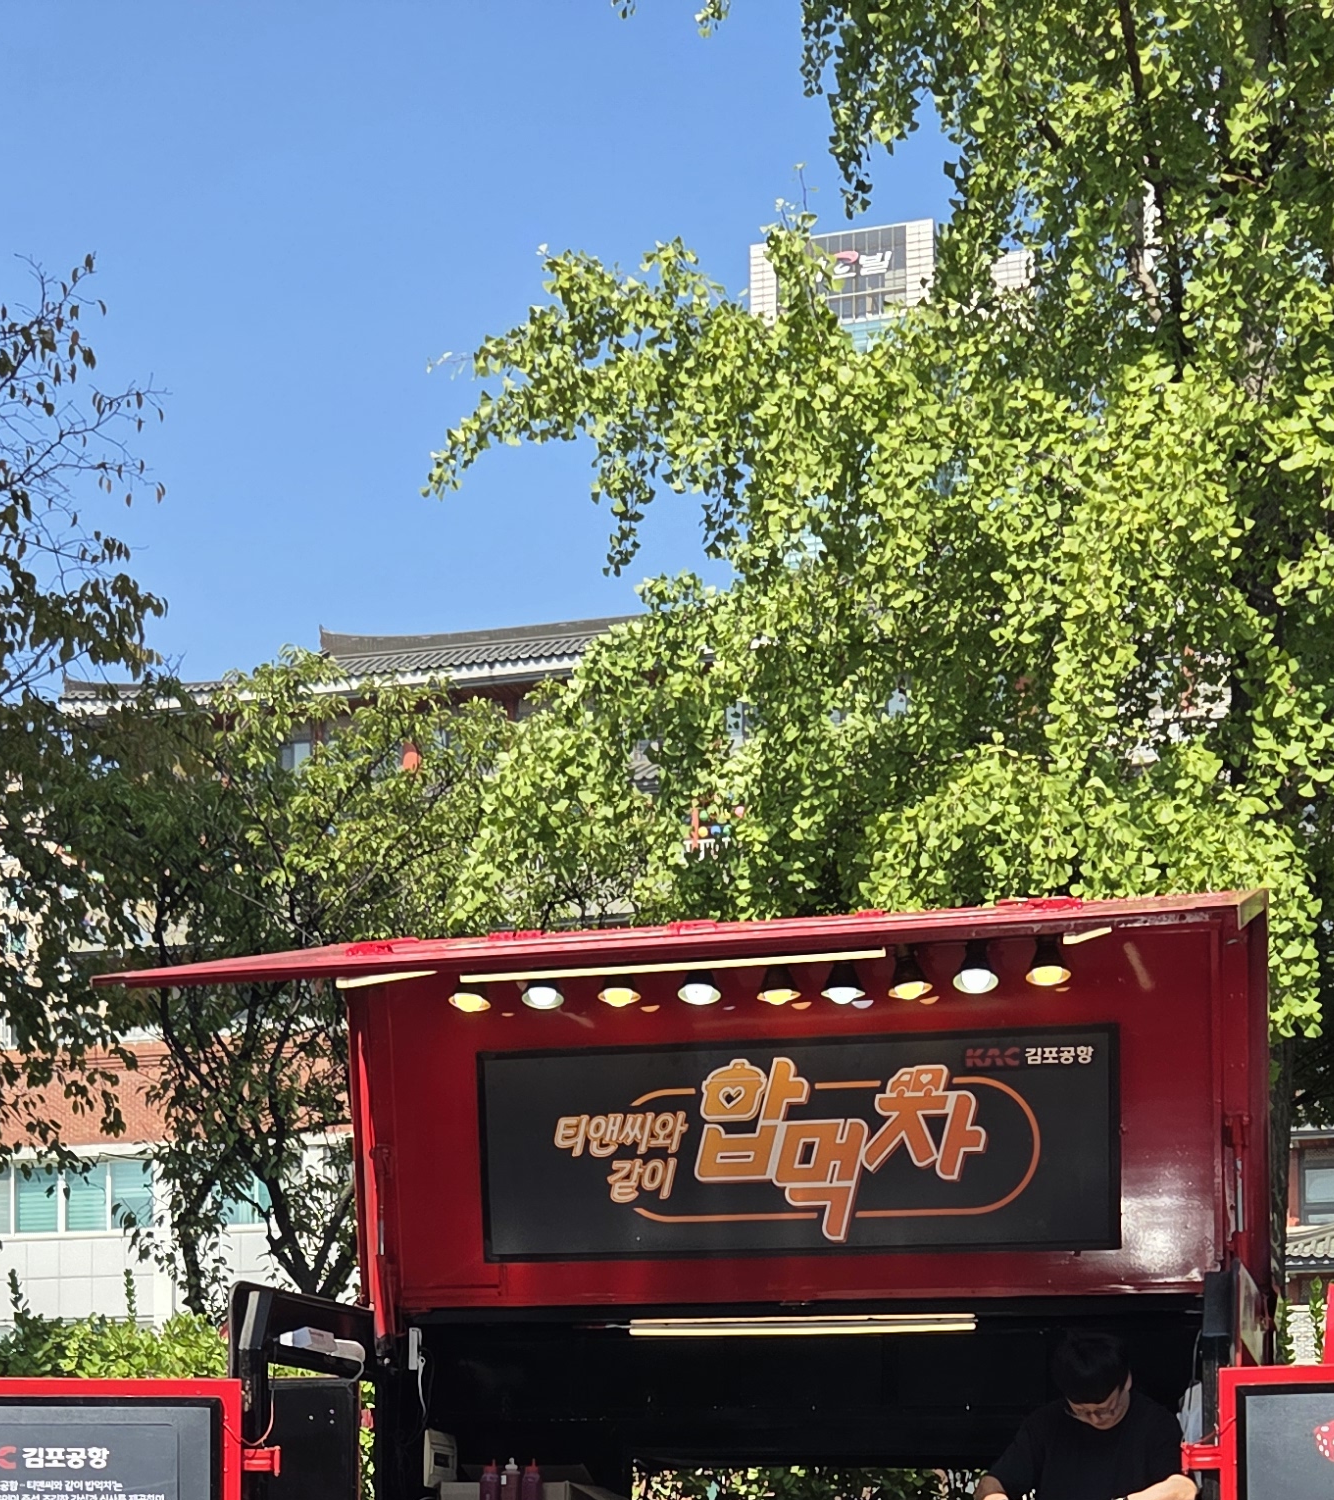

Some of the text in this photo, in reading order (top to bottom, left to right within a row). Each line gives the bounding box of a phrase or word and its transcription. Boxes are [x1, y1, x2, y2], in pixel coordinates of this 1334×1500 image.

[965, 1045, 1095, 1067] KAC 김포공항
[553, 1111, 688, 1158] 티앤씨와
[607, 1158, 677, 1204] 같이
[22, 1446, 110, 1469] 김포공항
[64, 1480, 83, 1492] 같이
